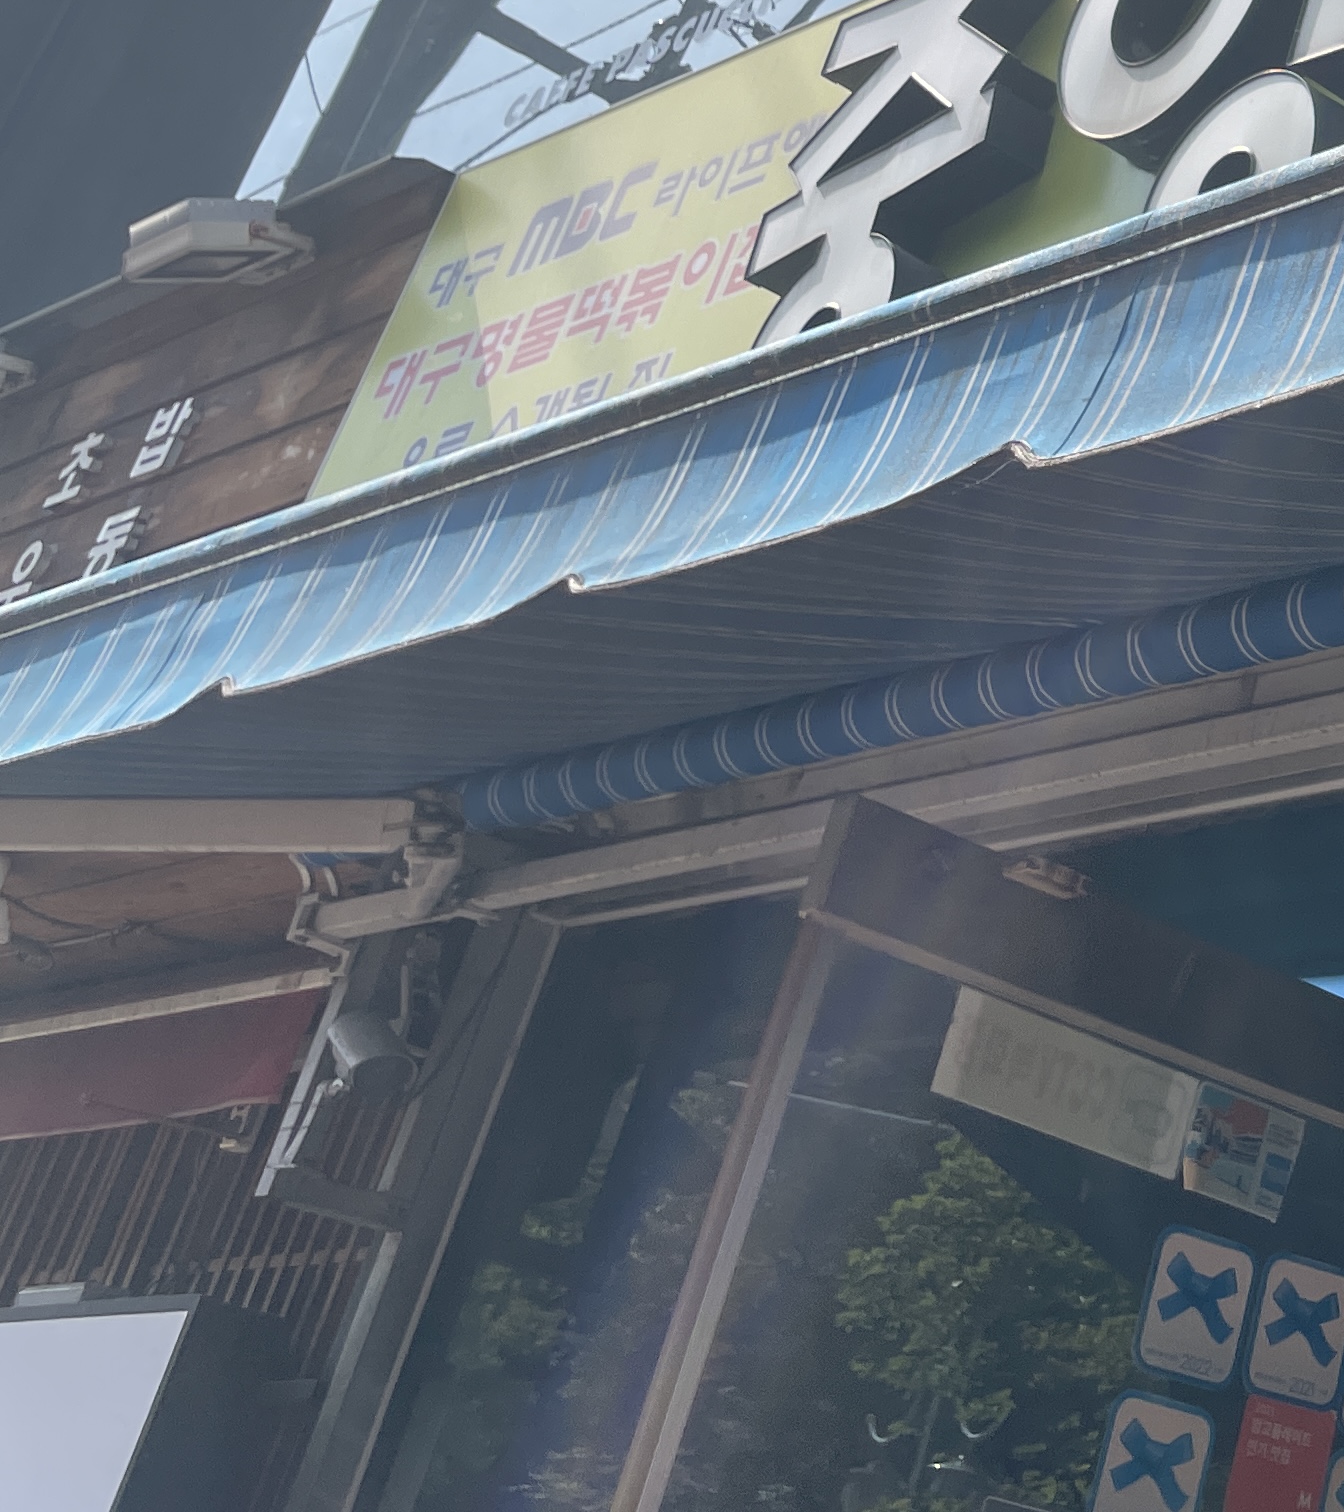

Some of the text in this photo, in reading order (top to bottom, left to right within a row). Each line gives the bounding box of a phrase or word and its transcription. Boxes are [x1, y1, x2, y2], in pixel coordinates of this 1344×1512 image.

[504, 61, 603, 129] CAFFE
[428, 242, 505, 309] 대구
[504, 159, 660, 278] MBC
